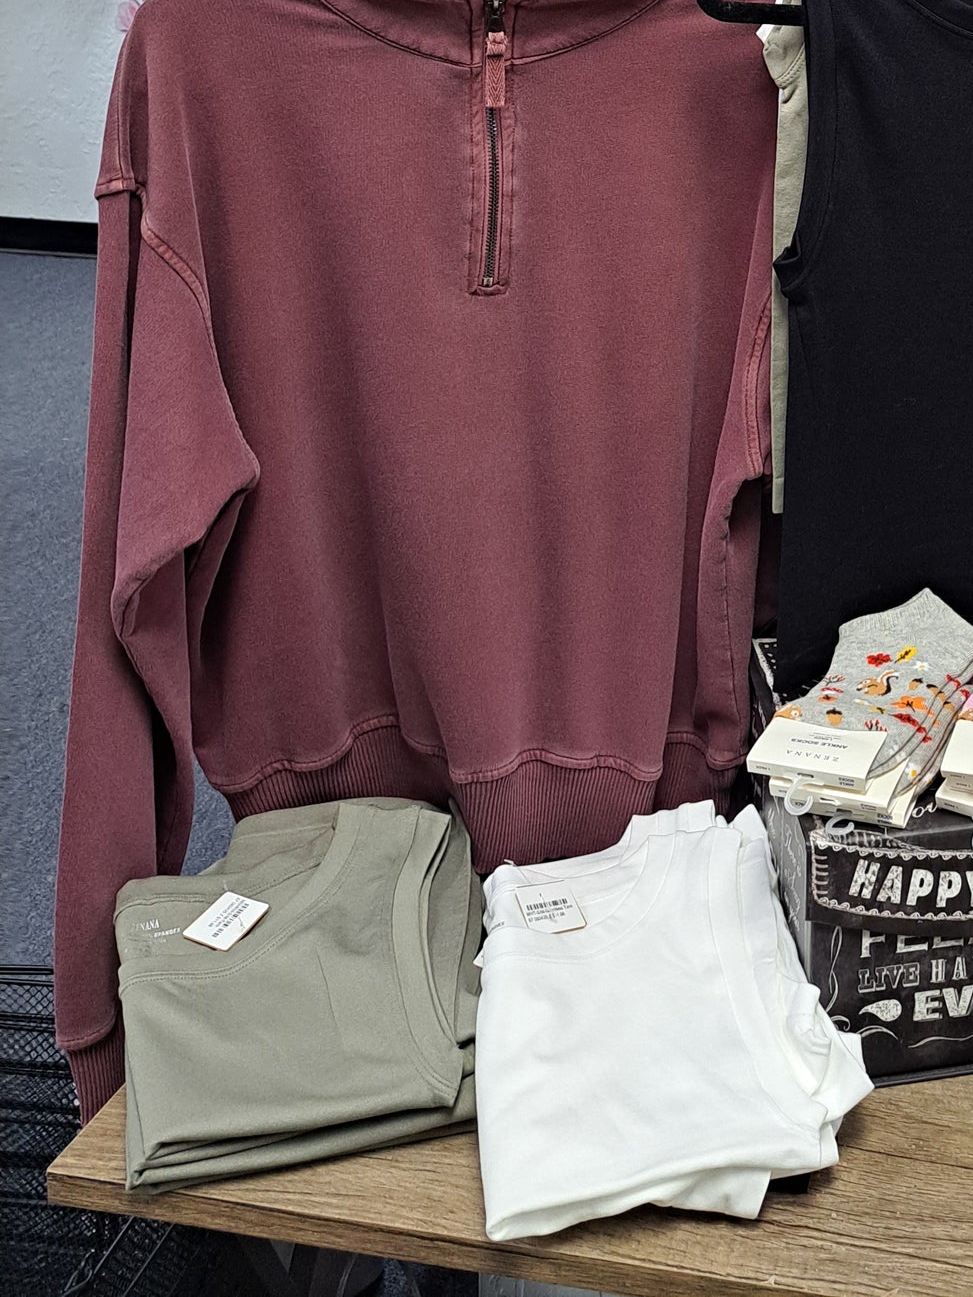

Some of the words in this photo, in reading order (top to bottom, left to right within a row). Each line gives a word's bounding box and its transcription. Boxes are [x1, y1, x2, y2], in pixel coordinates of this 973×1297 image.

[790, 738, 820, 746] SOCKS
[786, 749, 839, 762] ZENANA
[858, 962, 920, 993] LIVE
